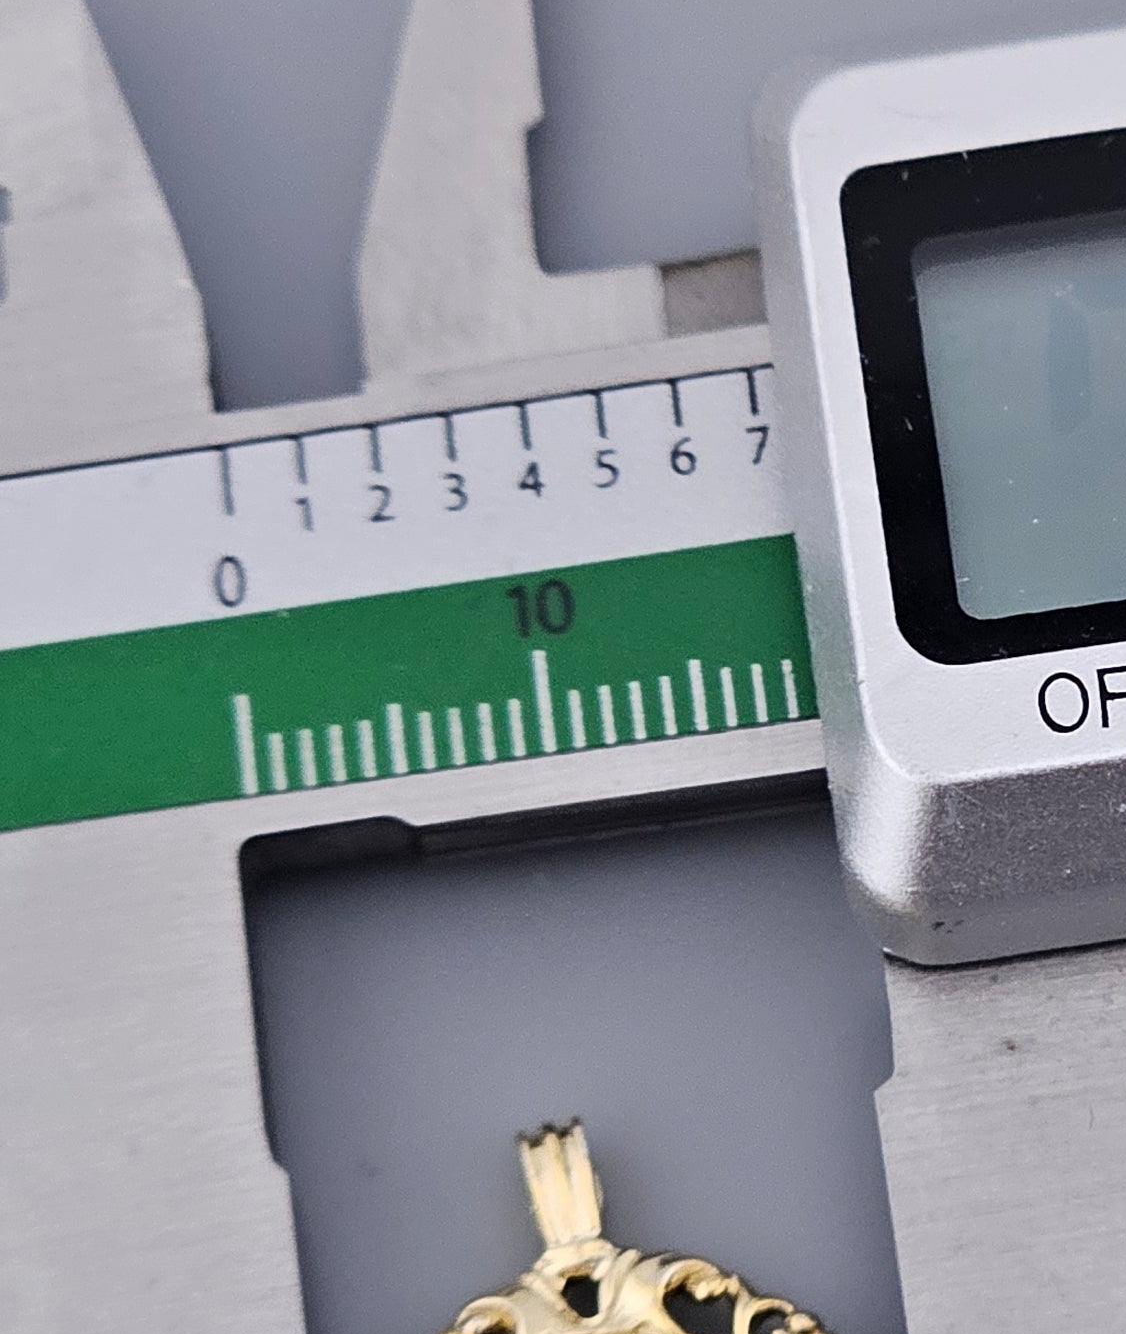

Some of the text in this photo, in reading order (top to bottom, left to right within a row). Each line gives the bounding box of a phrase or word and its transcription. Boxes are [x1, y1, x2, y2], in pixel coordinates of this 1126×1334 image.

[213, 426, 770, 609] 0 1 2 3 4 5 6 7
[506, 579, 575, 639] 10
